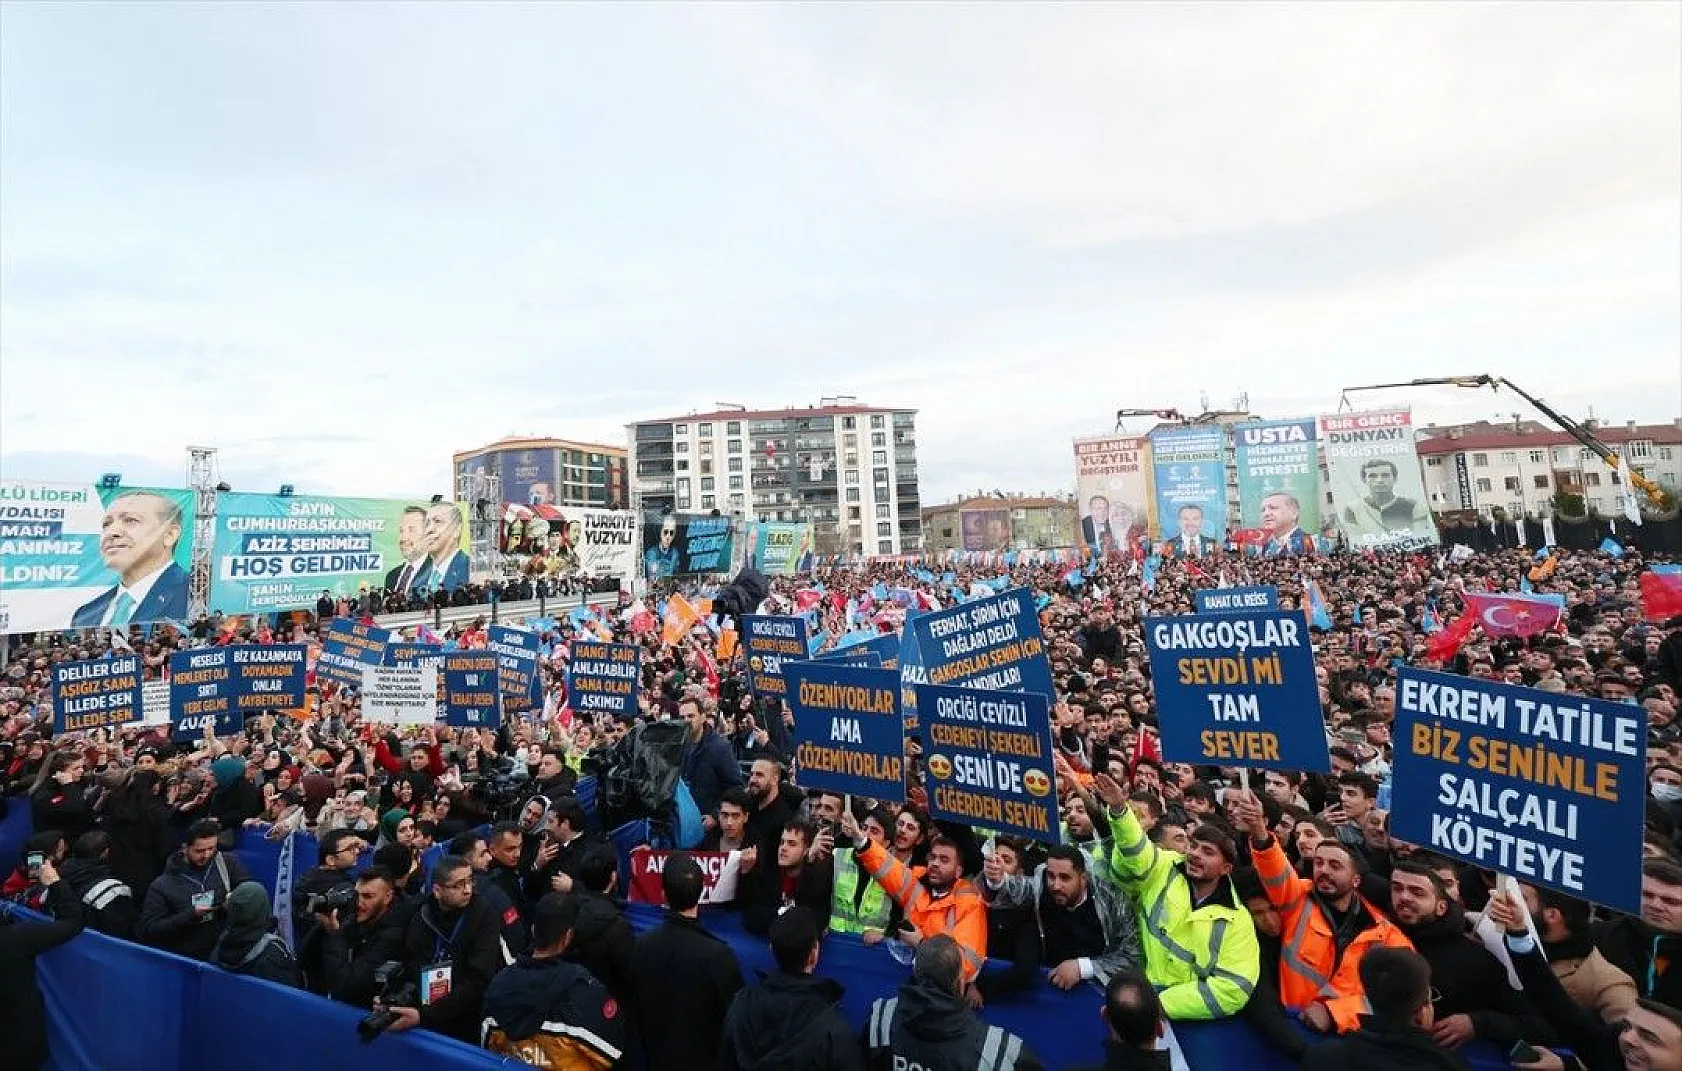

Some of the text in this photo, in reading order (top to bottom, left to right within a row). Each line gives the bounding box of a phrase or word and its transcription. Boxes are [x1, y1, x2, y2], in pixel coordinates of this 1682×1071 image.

[1244, 425, 1307, 445] USTA
[1326, 417, 1354, 430] BİR
[30, 487, 88, 502] LİDERİ
[289, 502, 335, 516] SAYIN
[226, 517, 386, 533] CUMHURBAŞKANIMIZ
[247, 535, 370, 554] AZİZ ŞEHRİMİZE
[230, 556, 284, 577] HOŞ
[1204, 595, 1231, 610] RAHAT
[1233, 595, 1244, 608] OL
[928, 596, 1021, 639] FERHAT, ŞİRİN İÇİN
[942, 617, 1018, 658] DAĞLARI DELDİ
[1154, 618, 1301, 652] GAKGOŞLAR
[233, 649, 250, 663] BİZ
[1020, 636, 1042, 660] İÇİN
[58, 657, 136, 682] DELİLER GİBİ
[572, 661, 637, 679] ANLATABİLİR
[1178, 651, 1283, 685] SEVDİ Mİ
[103, 675, 137, 691] SANA
[252, 679, 283, 691] ONLAR
[574, 678, 632, 694] SANA OLAN
[65, 695, 107, 714] İLLEDE
[109, 691, 132, 706] SEN
[580, 694, 625, 710] AŞKIMIZI
[799, 678, 895, 715] ÖZENİYORLAR
[1208, 694, 1261, 722] TAM
[65, 707, 132, 730] İLLEDE SEN
[936, 694, 978, 721] ORCİĞİ
[979, 698, 1028, 727] CEVİZLİ
[1401, 678, 1638, 757] EKREM TATİLE
[830, 716, 863, 745] AMA
[930, 722, 988, 751] ÇEDENEYİ
[989, 730, 1042, 758] ŞEKERLİ
[1200, 729, 1281, 761] SEVER
[952, 751, 1023, 794] SENİ DE
[1411, 720, 1620, 802] BİZ SENİNLE
[935, 783, 1050, 833] CİĞERDEN SEVİK
[1437, 772, 1579, 841] SALÇALI
[1431, 813, 1586, 892] KÖFTEYE
